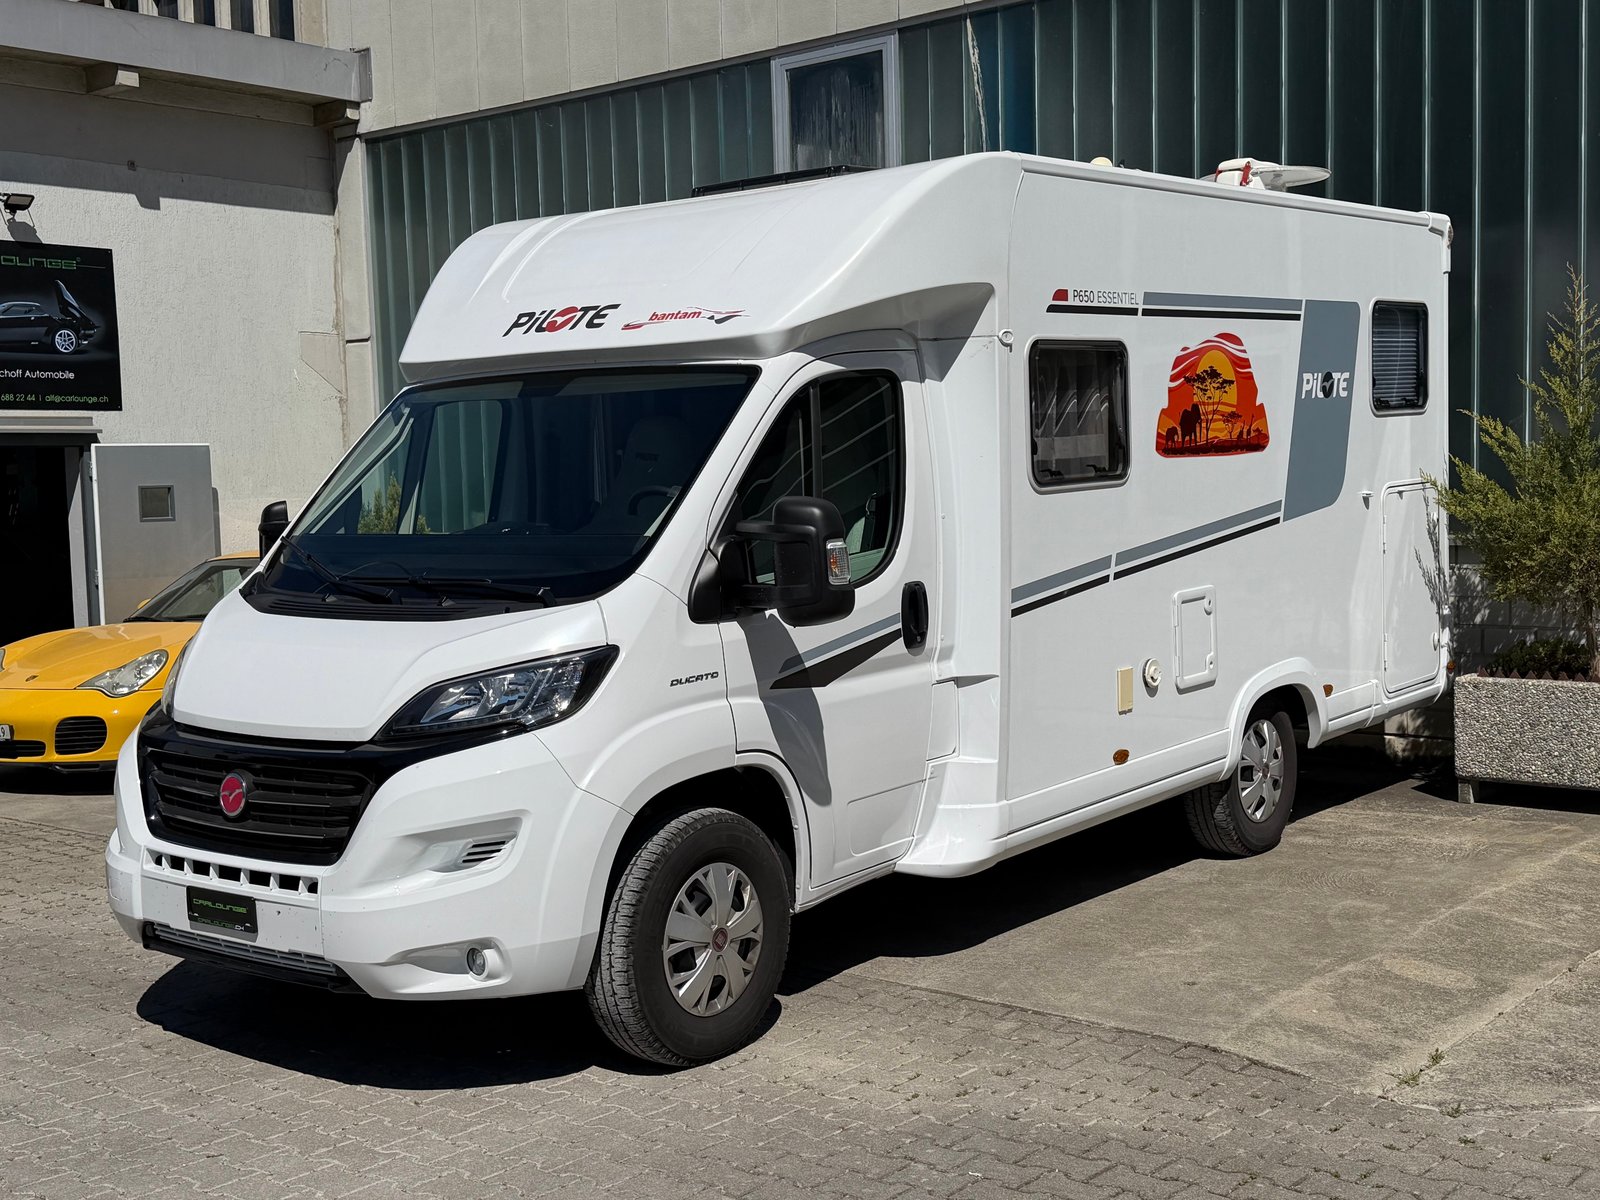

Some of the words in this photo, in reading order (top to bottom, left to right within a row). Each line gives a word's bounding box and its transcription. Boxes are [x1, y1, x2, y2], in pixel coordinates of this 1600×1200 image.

[1073, 289, 1095, 303] P650
[1097, 290, 1140, 305] ESSENTIEL
[648, 310, 702, 322] bantam
[25, 370, 75, 380] Automobile
[1, 393, 14, 402] 688
[16, 393, 25, 402] 22
[27, 394, 36, 402] 44
[45, 394, 109, 404] alf@carlounge.ch
[670, 671, 719, 687] DUCATO
[193, 898, 247, 914] CARLOUNGE
